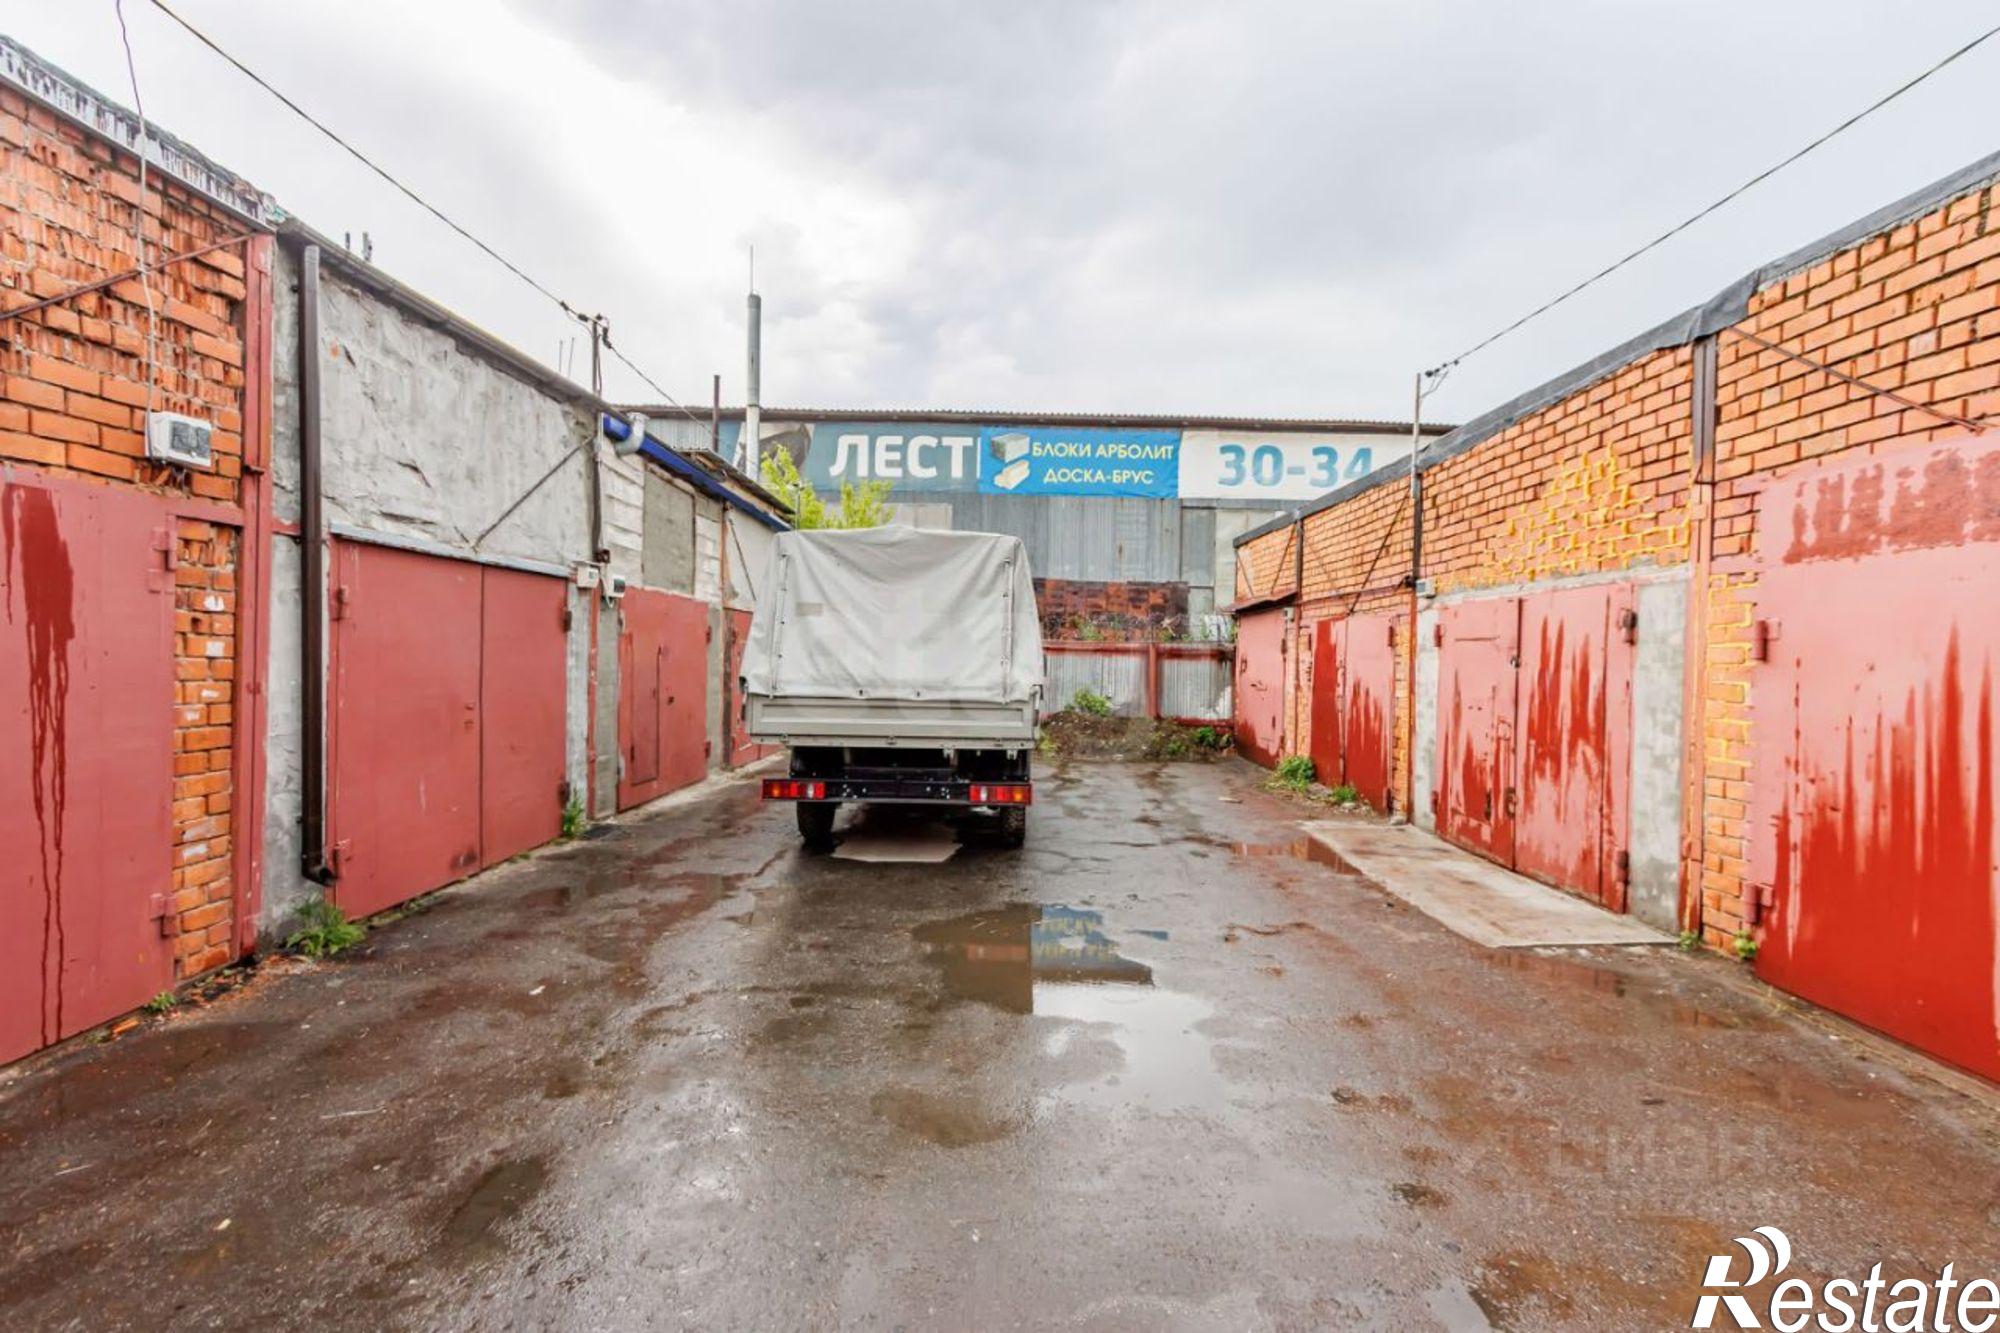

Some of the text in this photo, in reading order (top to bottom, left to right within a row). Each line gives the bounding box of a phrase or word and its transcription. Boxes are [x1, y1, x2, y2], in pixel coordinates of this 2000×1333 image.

[829, 434, 981, 479] ЛЕСТ
[1031, 441, 1174, 459] БЛОКИ АРБОЛИТ
[1043, 468, 1155, 485] ДОСКА-БРУС
